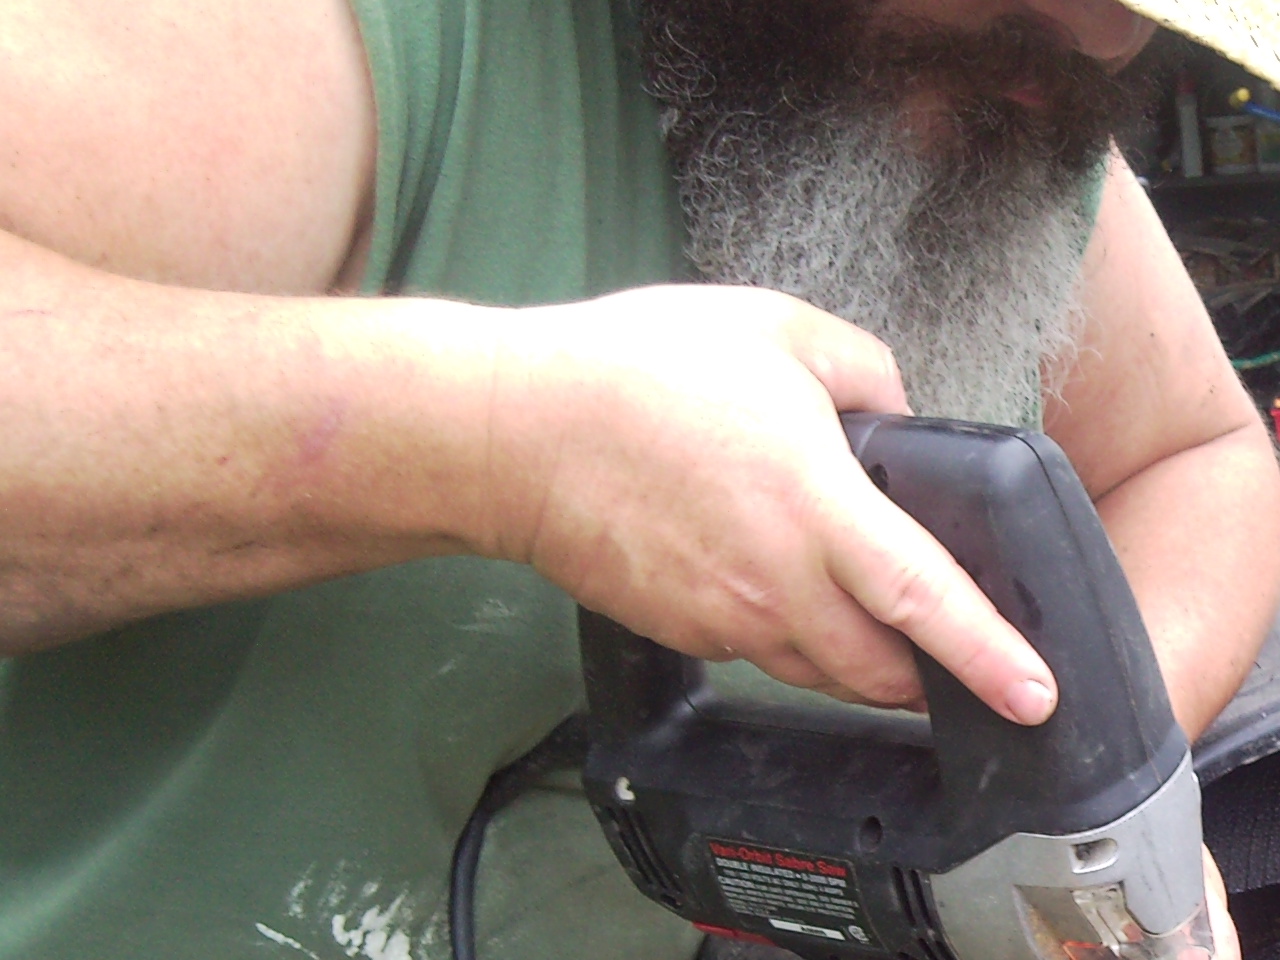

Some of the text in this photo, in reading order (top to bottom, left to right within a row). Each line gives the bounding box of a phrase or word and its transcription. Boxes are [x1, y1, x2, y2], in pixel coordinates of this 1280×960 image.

[709, 842, 847, 878] Vari-Orbit Sabre Saw
